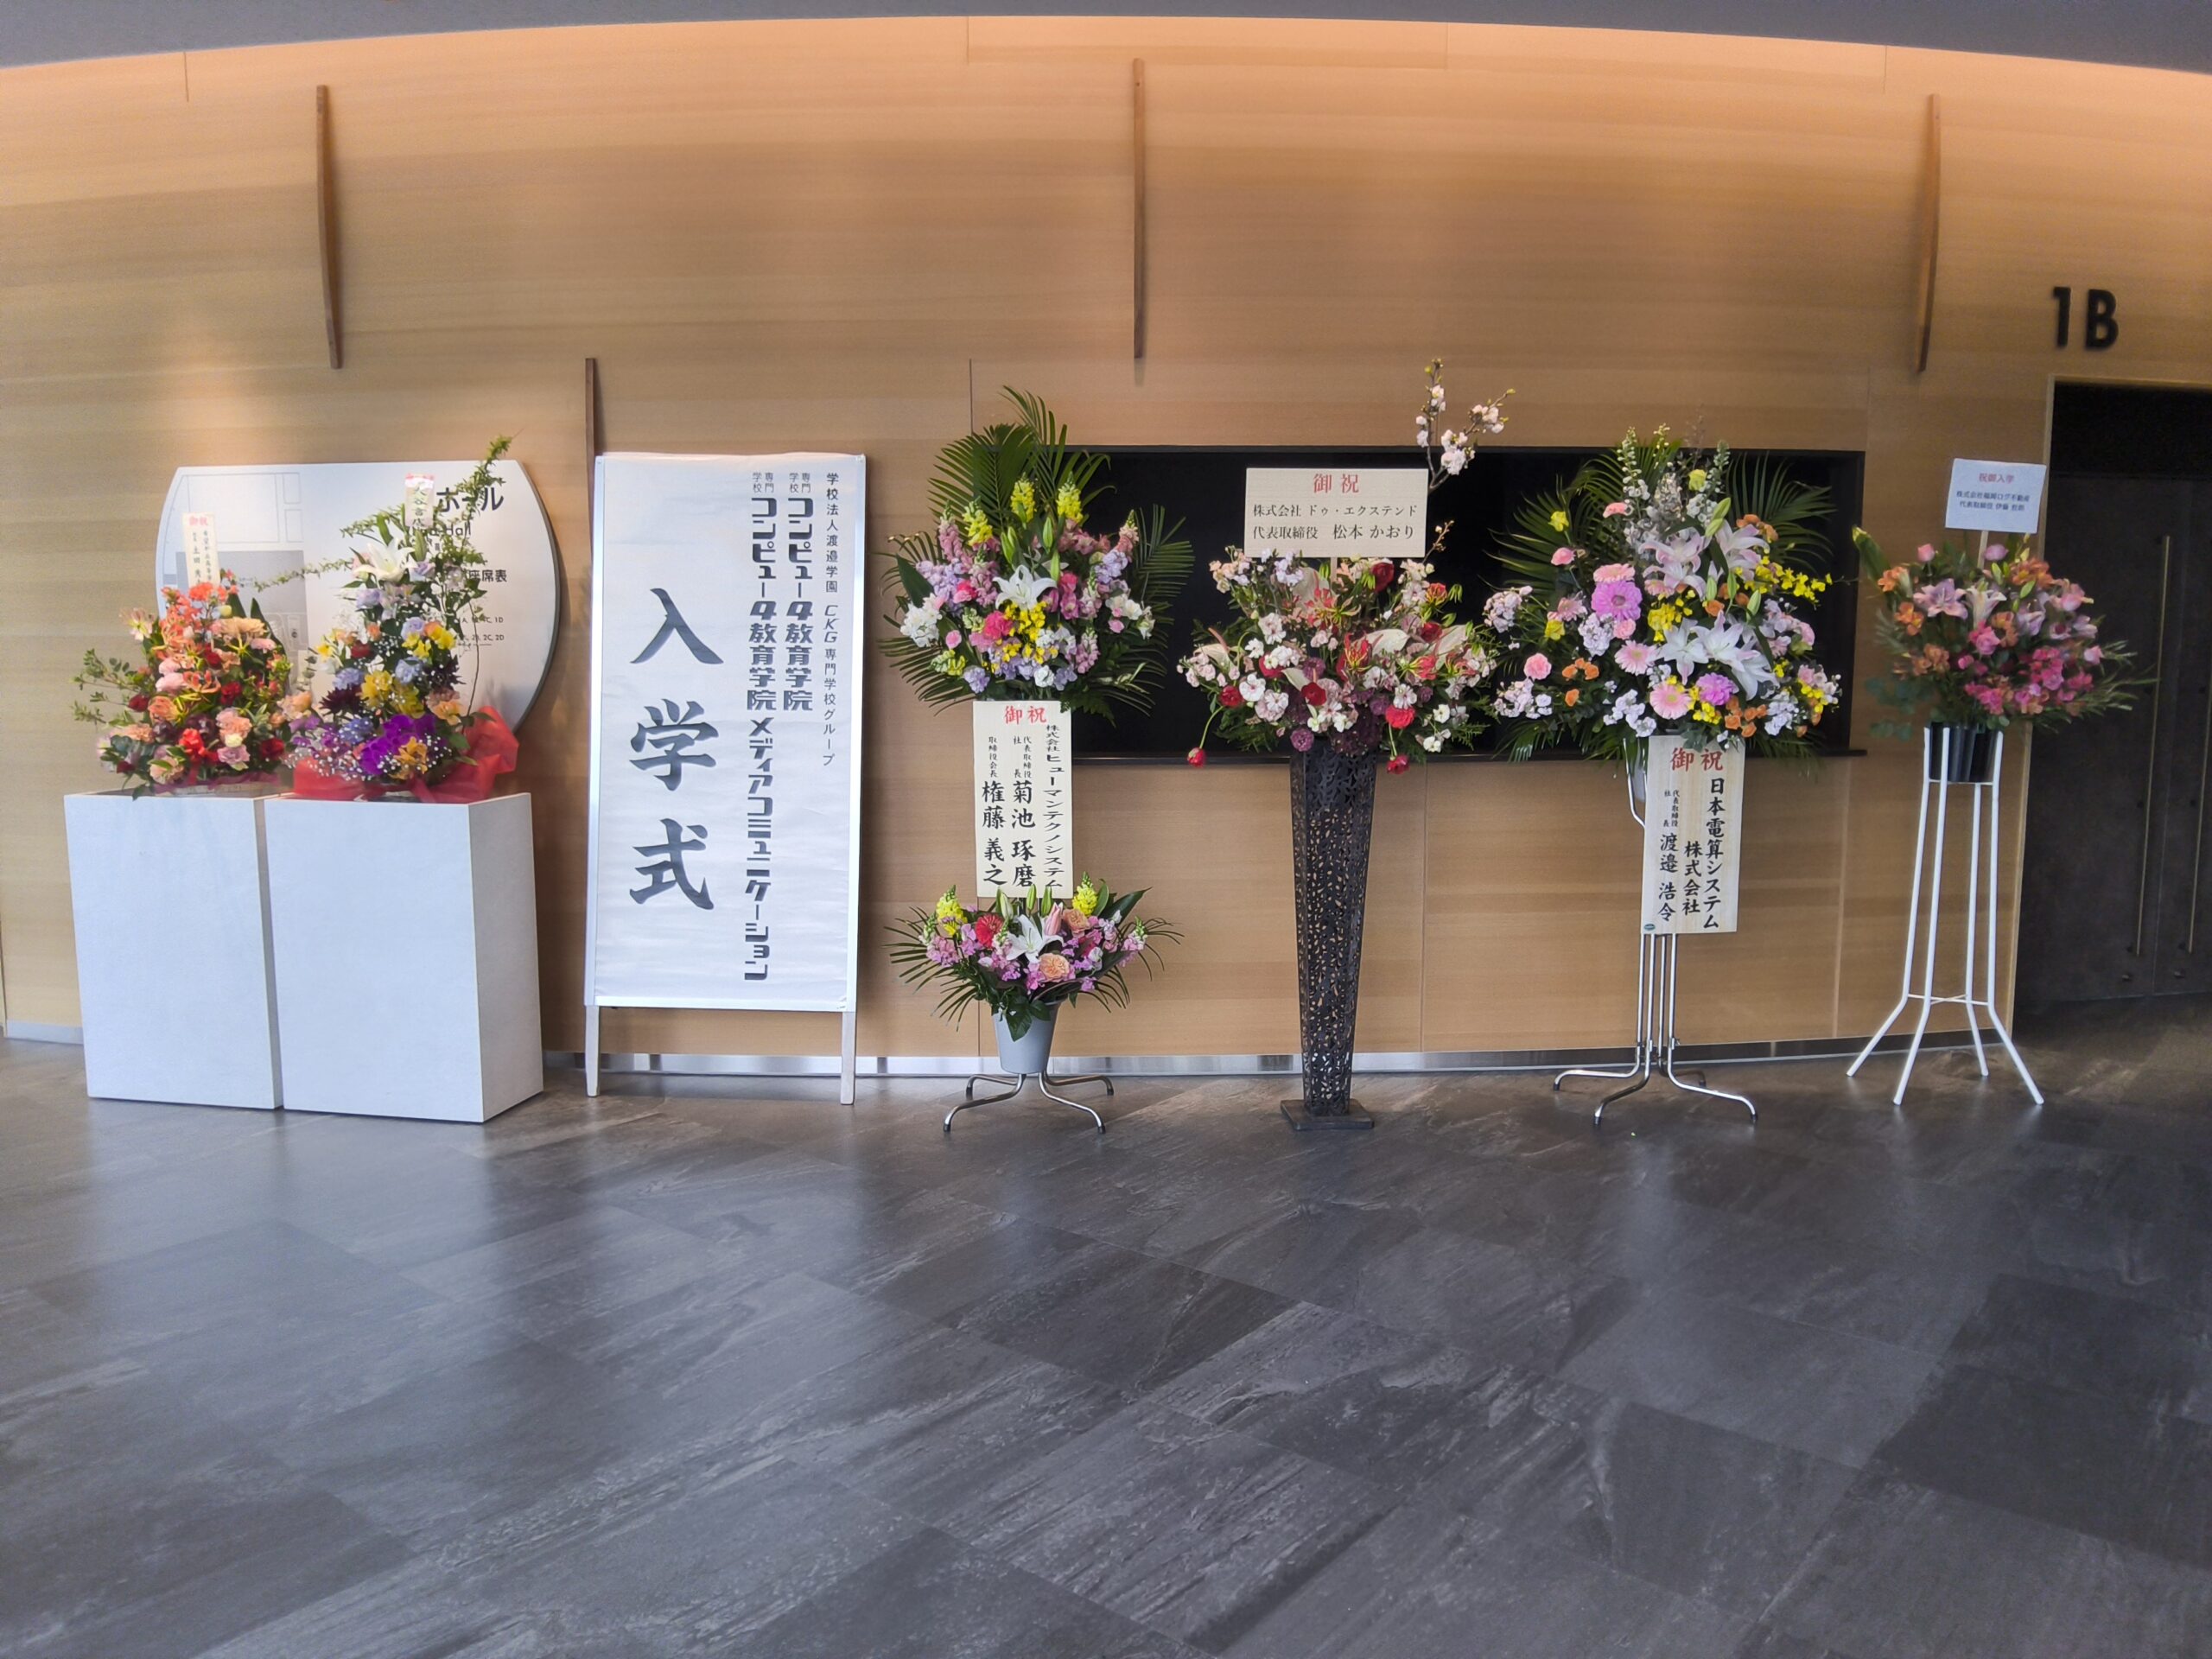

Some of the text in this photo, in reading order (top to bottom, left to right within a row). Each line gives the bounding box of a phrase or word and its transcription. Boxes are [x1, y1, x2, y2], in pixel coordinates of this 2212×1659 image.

[2052, 286, 2119, 351] 1B
[1313, 474, 1359, 493] 御祝
[1253, 505, 1301, 517] 株式会社
[1253, 524, 1414, 540] 代表取締役 松本 かおり
[1005, 706, 1047, 724] 御祝
[629, 588, 724, 910] 入学式
[1670, 747, 1724, 772] 御祝
[983, 837, 1007, 886] 義之
[1703, 778, 1726, 929] 日本電算システム
[1682, 841, 1703, 916] 株式会社
